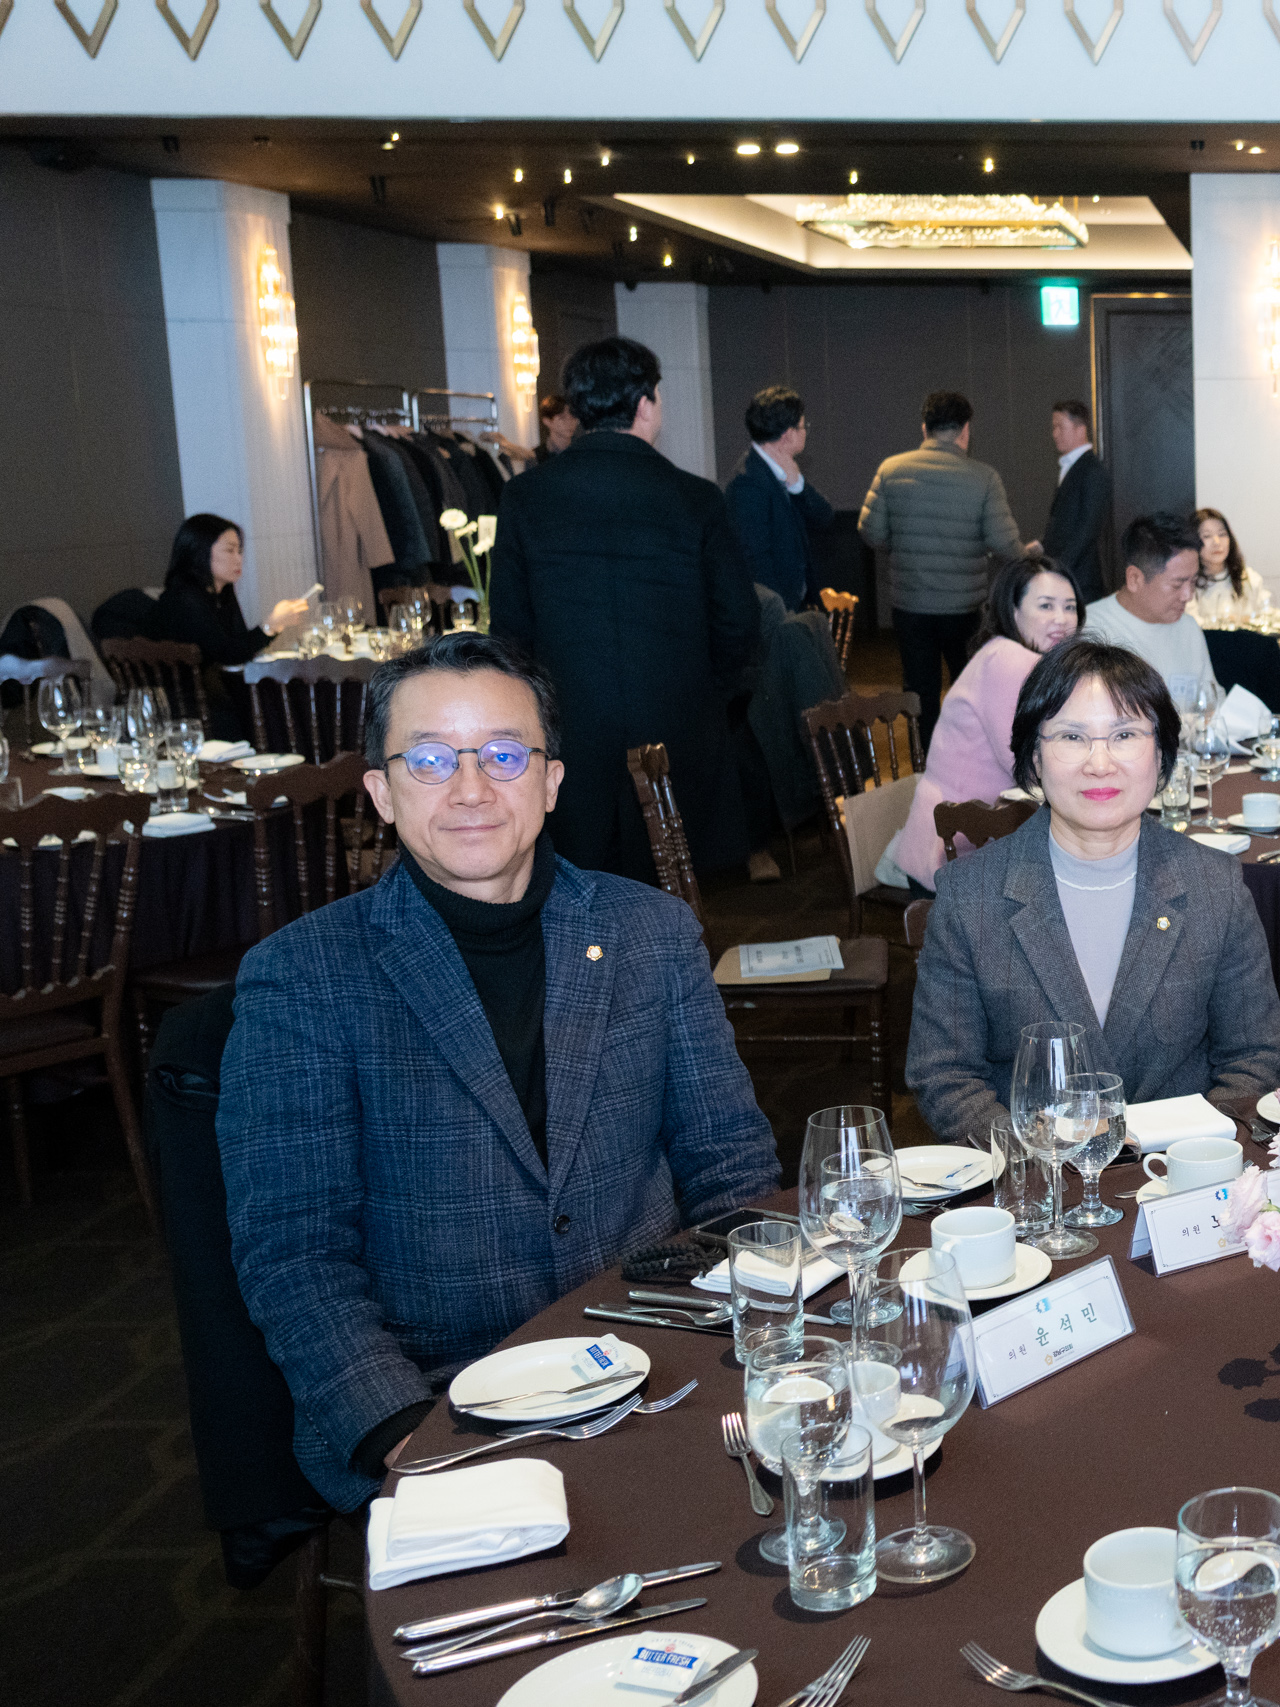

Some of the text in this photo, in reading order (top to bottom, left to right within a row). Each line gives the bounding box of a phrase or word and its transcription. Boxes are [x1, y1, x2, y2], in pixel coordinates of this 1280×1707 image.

[1182, 1224, 1201, 1237] 의원
[1008, 1302, 1098, 1360] 의원 윤석민
[638, 1648, 692, 1667] BUTTER FRESH
